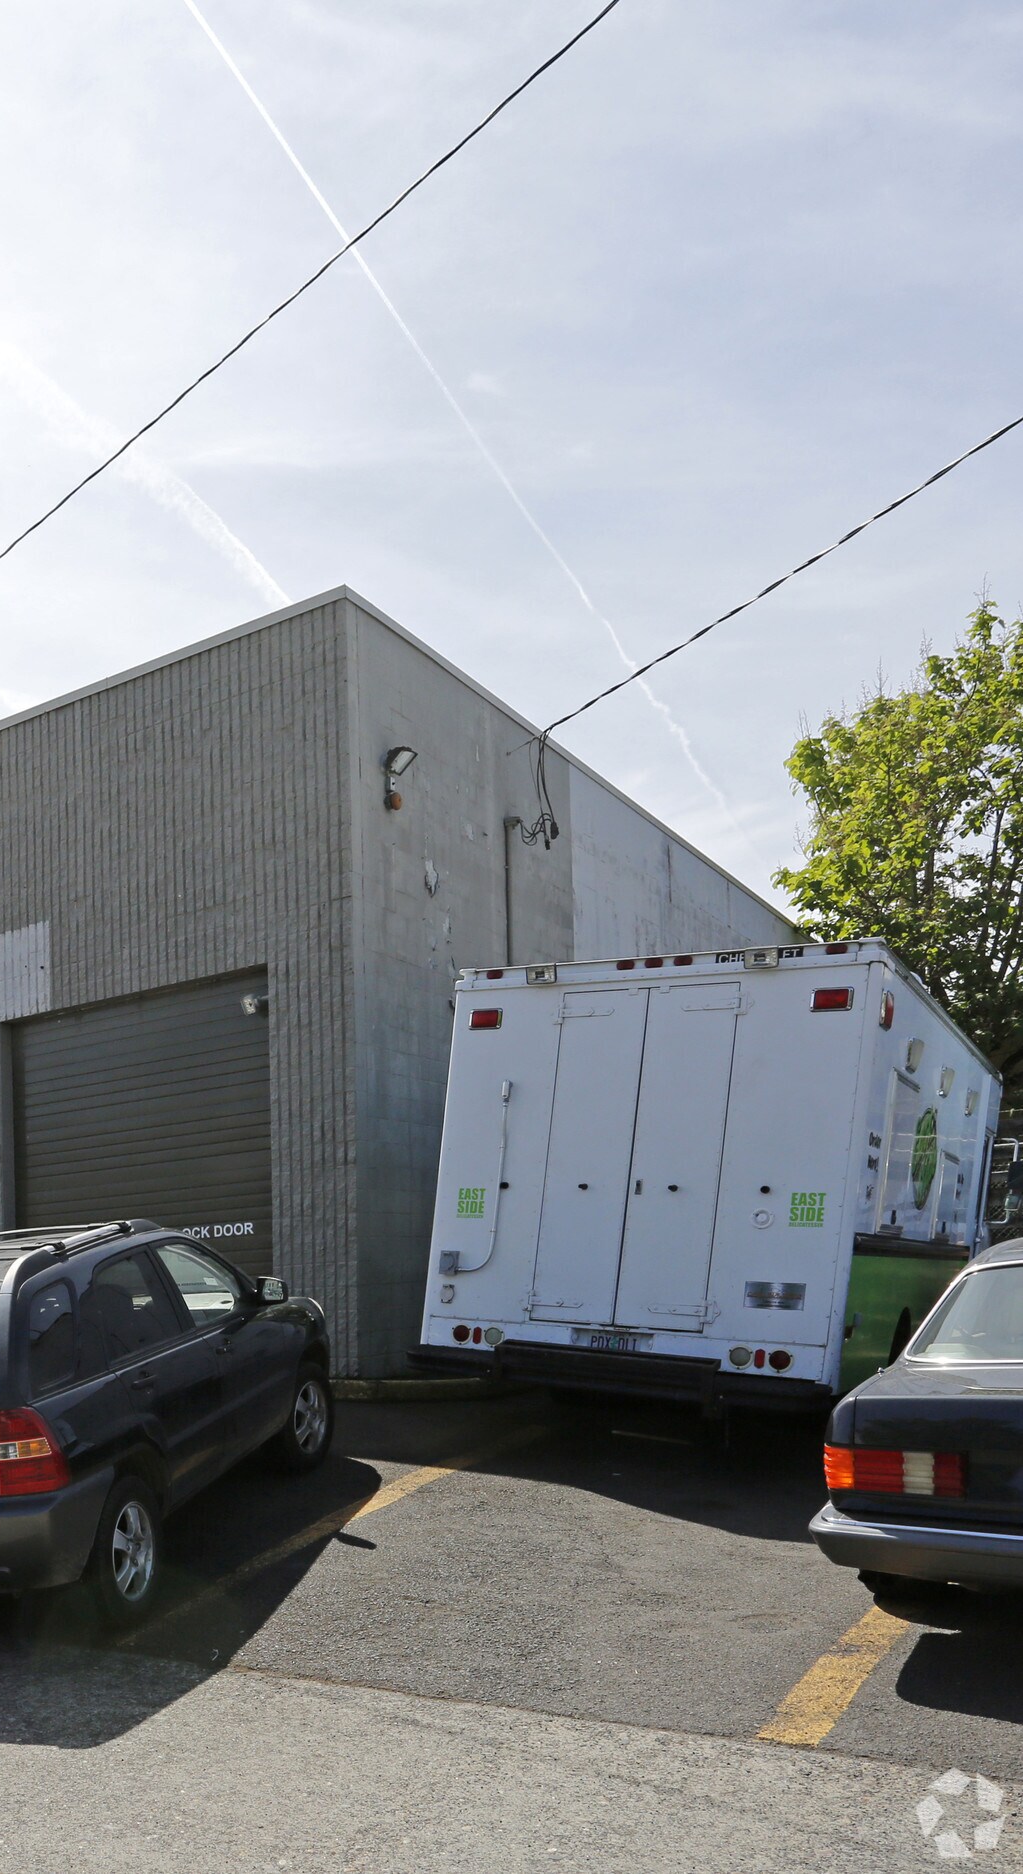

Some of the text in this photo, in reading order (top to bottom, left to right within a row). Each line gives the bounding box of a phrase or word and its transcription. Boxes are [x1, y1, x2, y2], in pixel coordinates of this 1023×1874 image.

[458, 1187, 486, 1200] EAST
[790, 1192, 827, 1206] EAST
[457, 1200, 485, 1213] SIDE
[789, 1206, 825, 1222] SIDE
[213, 1222, 254, 1238] DOOR
[590, 1336, 611, 1349] PDX
